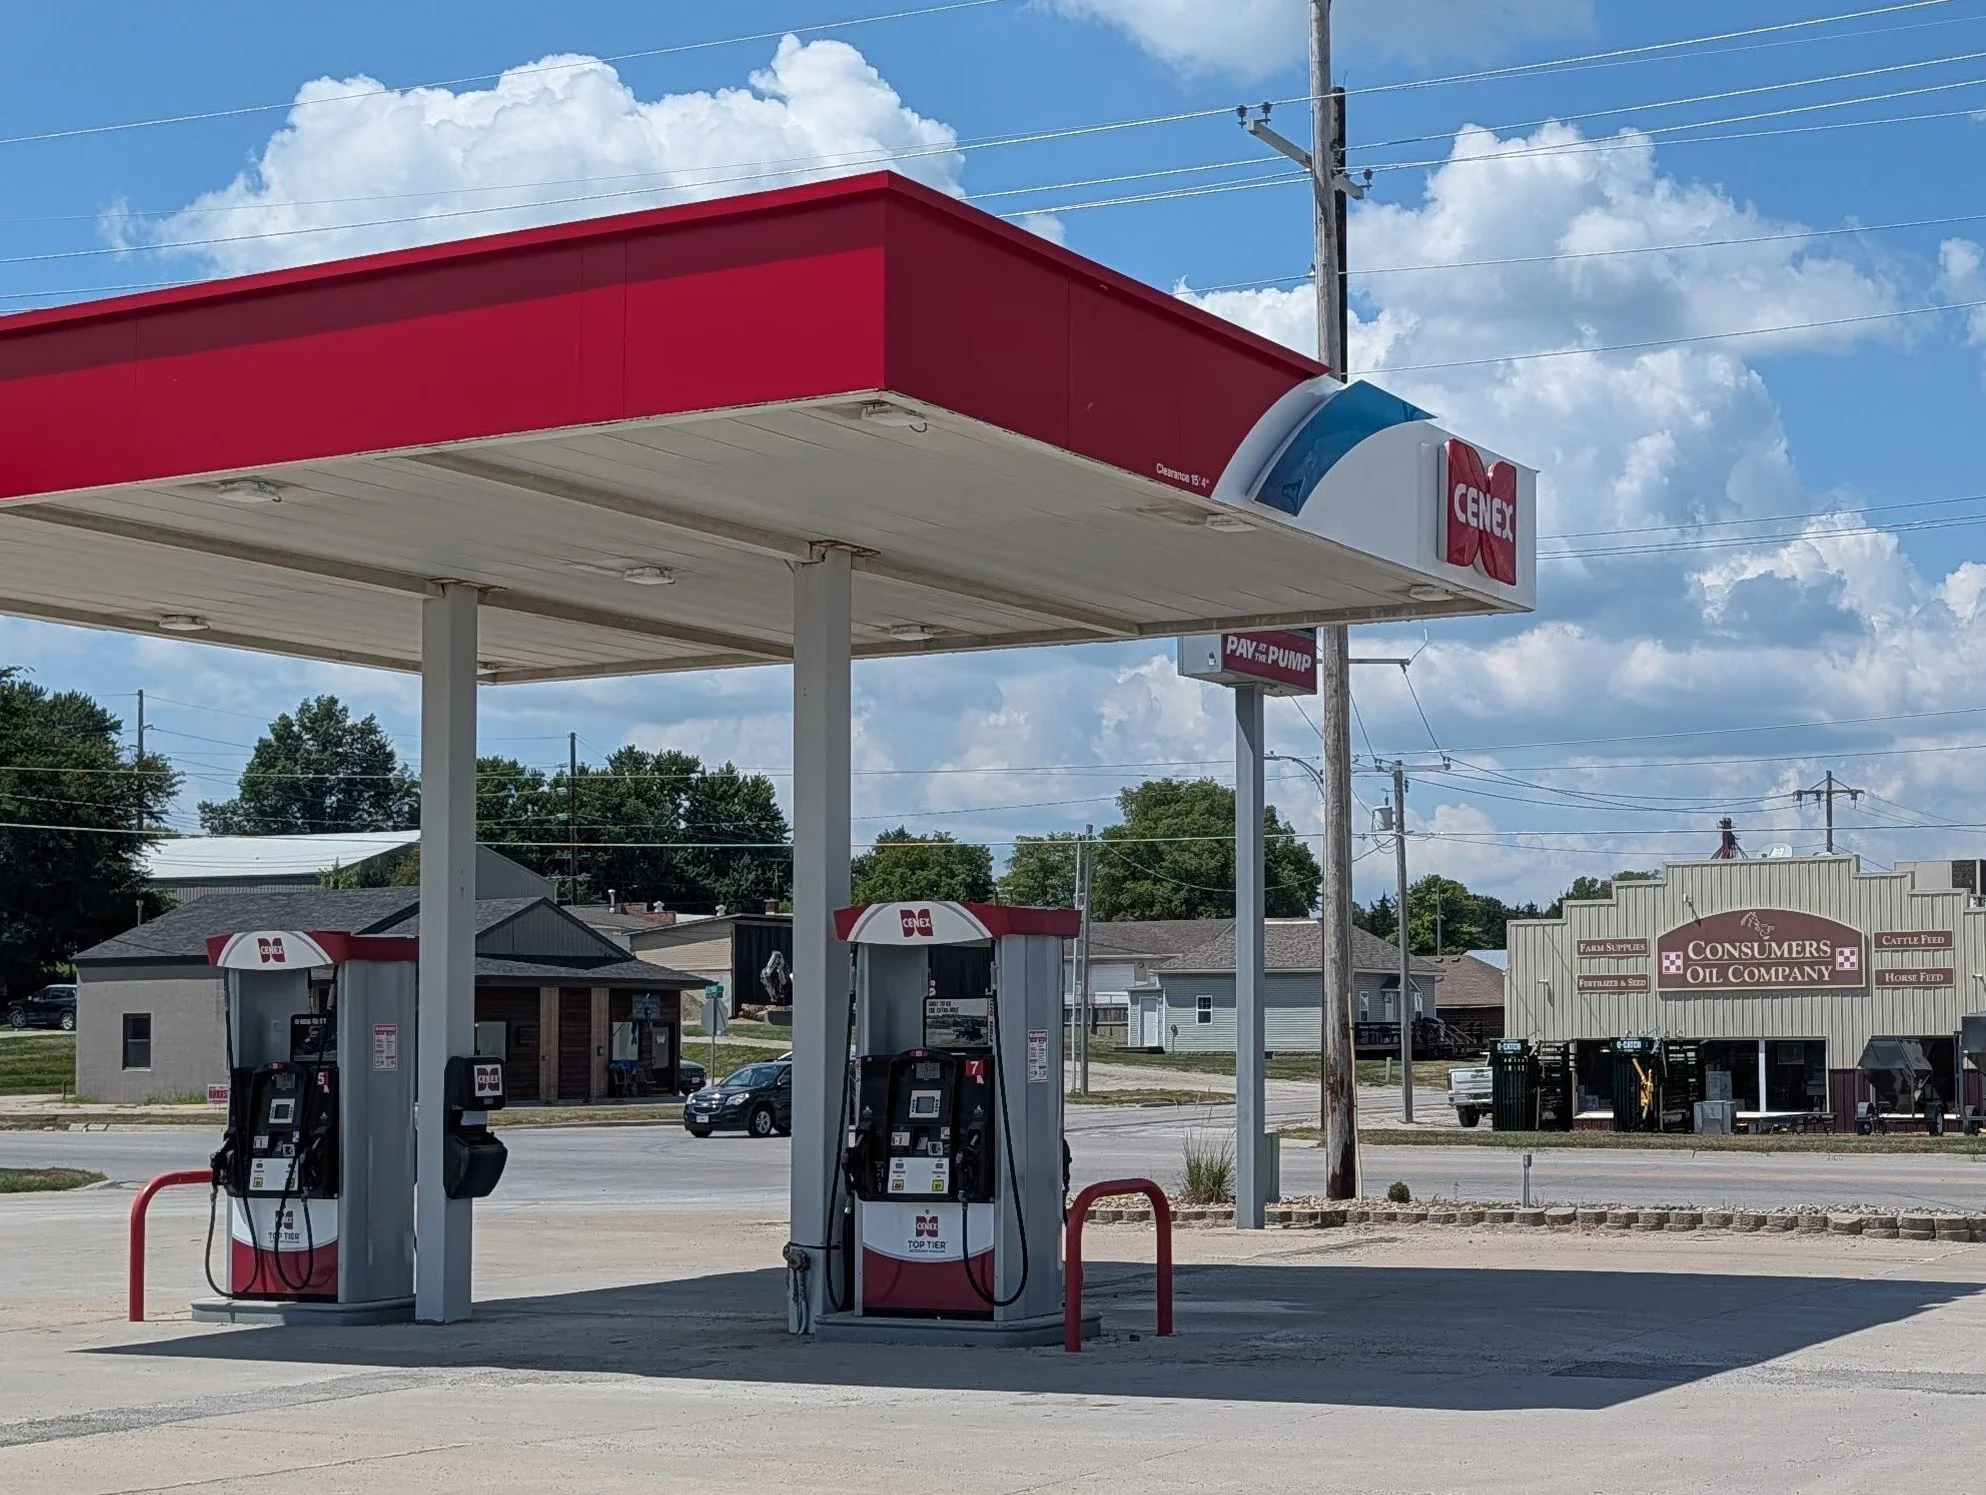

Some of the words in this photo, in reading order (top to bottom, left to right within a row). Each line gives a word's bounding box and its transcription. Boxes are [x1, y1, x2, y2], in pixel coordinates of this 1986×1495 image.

[1156, 462, 1190, 483] Clearance
[1454, 482, 1514, 543] CENEX
[1226, 635, 1257, 659] PAY
[1258, 642, 1268, 652] AT
[1267, 645, 1312, 673] PUMP
[902, 917, 931, 928] CENEX
[1882, 935, 1920, 945] CATTLE
[1920, 934, 1945, 945] FEED
[260, 945, 284, 955] CENEX
[1580, 943, 1605, 953] FARM
[1606, 942, 1646, 952] SUPPLIES
[1687, 940, 1832, 960] CONSUMERS
[1686, 965, 1724, 984] OIL
[1728, 964, 1833, 983] COMPANY
[1885, 972, 1918, 983] HORSE
[1919, 971, 1944, 982] FEED
[1620, 979, 1627, 987] &
[1627, 977, 1647, 987] SEED
[970, 1060, 979, 1075] 7
[317, 1071, 325, 1085] 5
[907, 1240, 925, 1249] TOP
[927, 1240, 946, 1249] TIER
